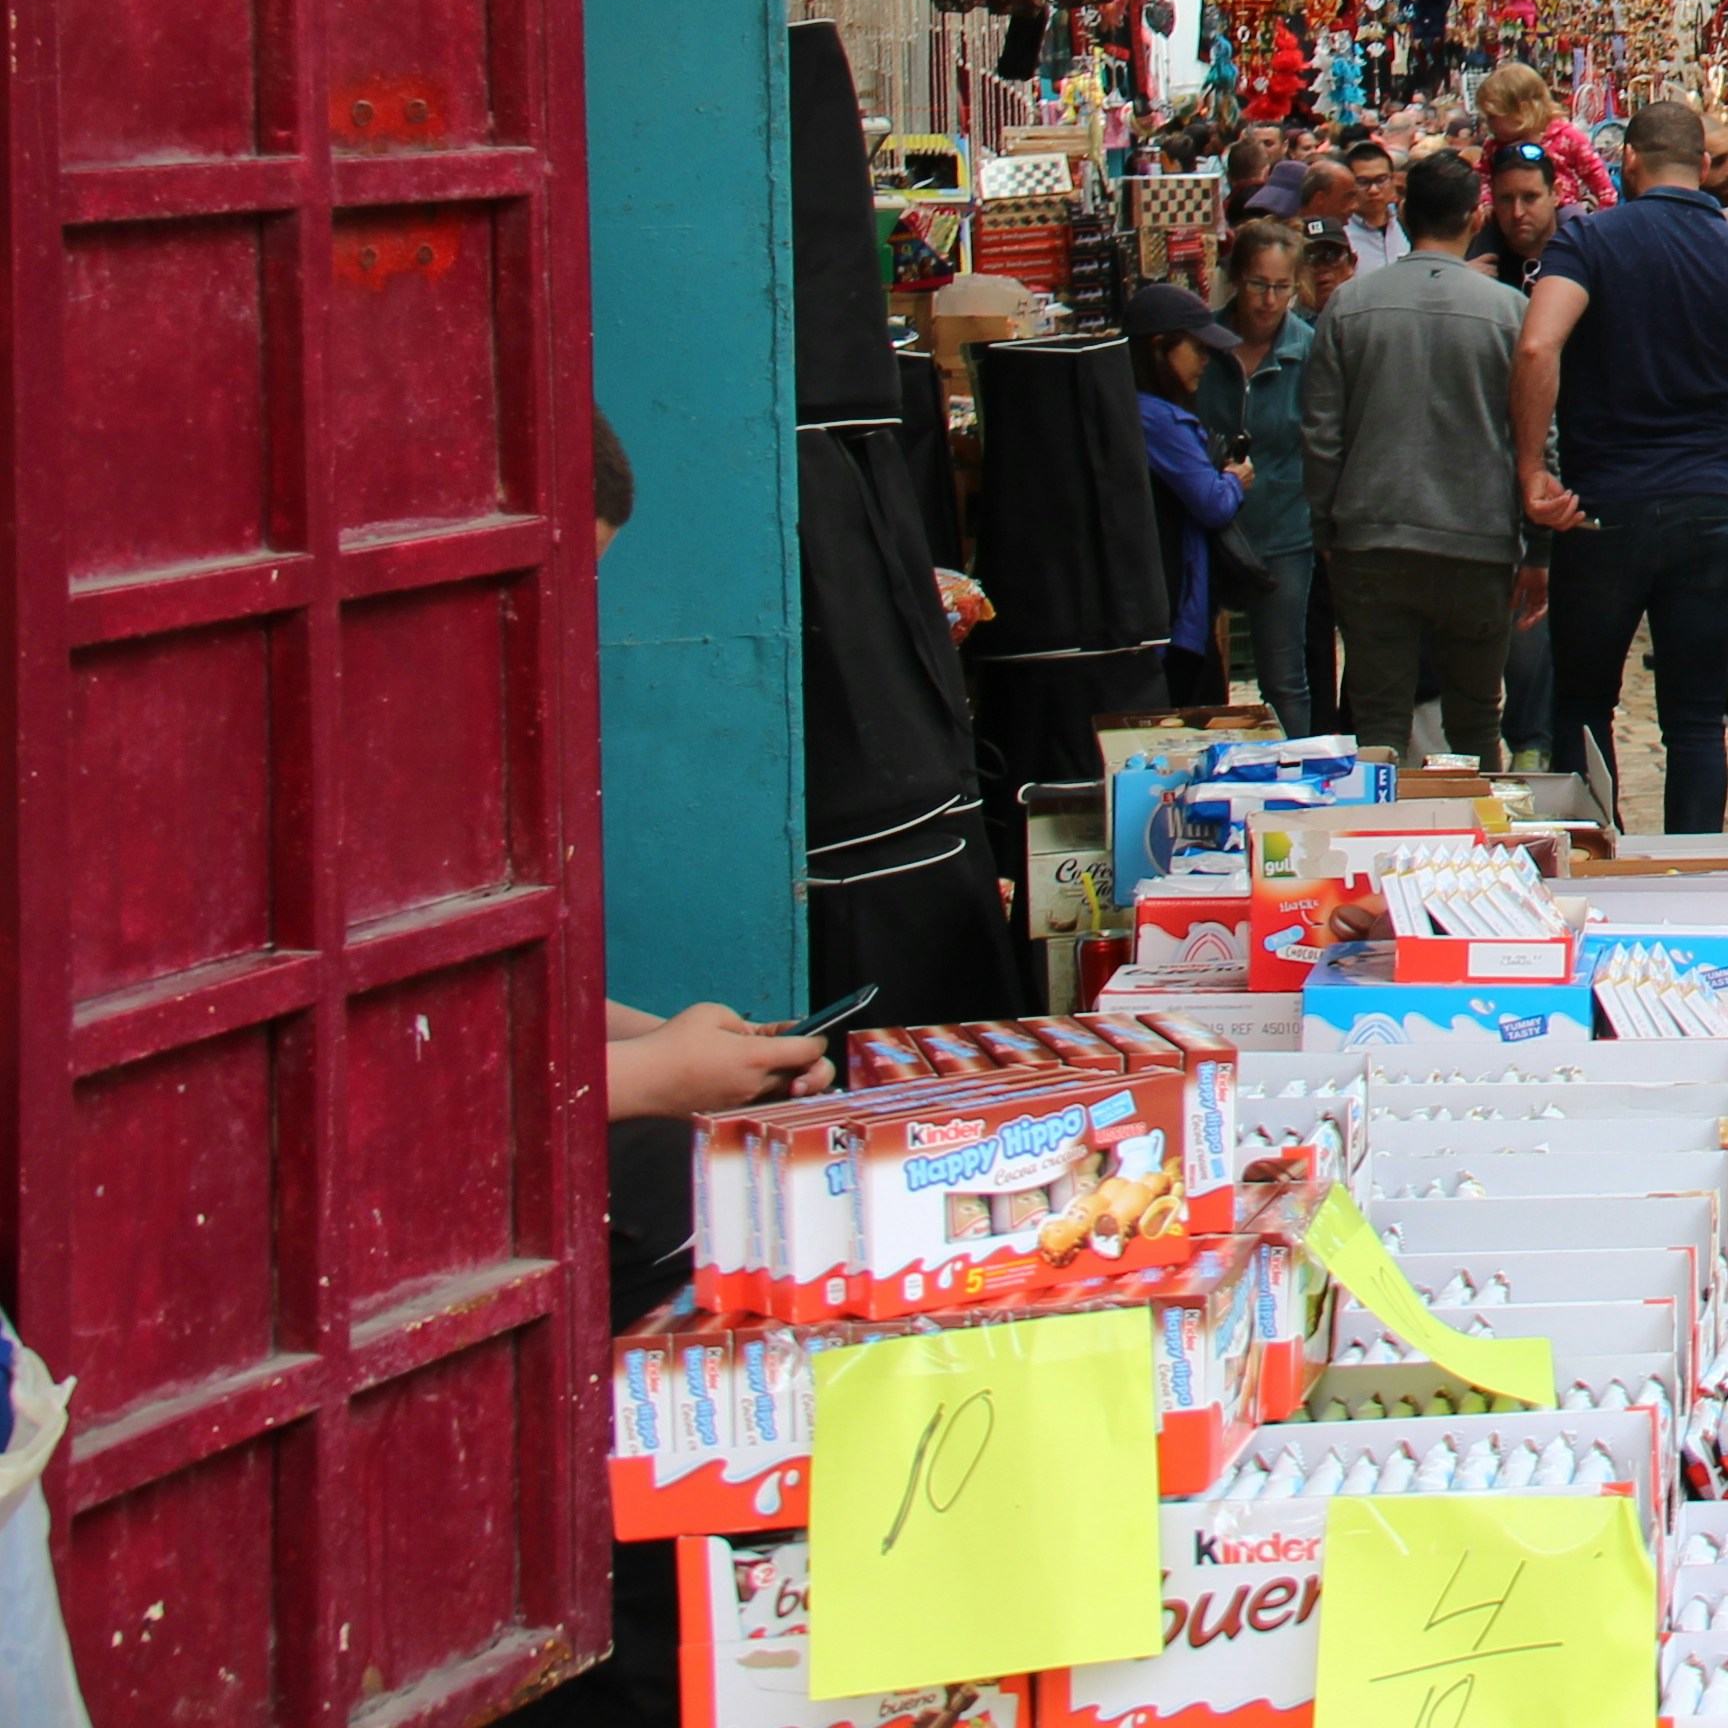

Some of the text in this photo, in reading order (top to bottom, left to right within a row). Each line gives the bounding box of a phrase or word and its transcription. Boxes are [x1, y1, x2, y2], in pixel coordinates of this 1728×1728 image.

[1231, 1022, 1252, 1035] REF
[1502, 1015, 1543, 1033] YUMMY
[1506, 1025, 1543, 1042] TASTY
[905, 1138, 999, 1190] Happy
[1000, 1104, 1086, 1158] Hippo
[1197, 1061, 1223, 1154] Happy Hippo
[993, 1162, 1037, 1186] Cocoa
[966, 1268, 986, 1293] 5
[1258, 1296, 1277, 1338] Hippo
[625, 1349, 659, 1449] Happy Hippo
[684, 1345, 717, 1446] Happy Hippo
[745, 1341, 777, 1441] Happy Hippo
[1163, 1307, 1192, 1407] Happy Hippo
[880, 1387, 995, 1557] 10
[1422, 1548, 1528, 1652] 4
[879, 1692, 937, 1717] bueno
